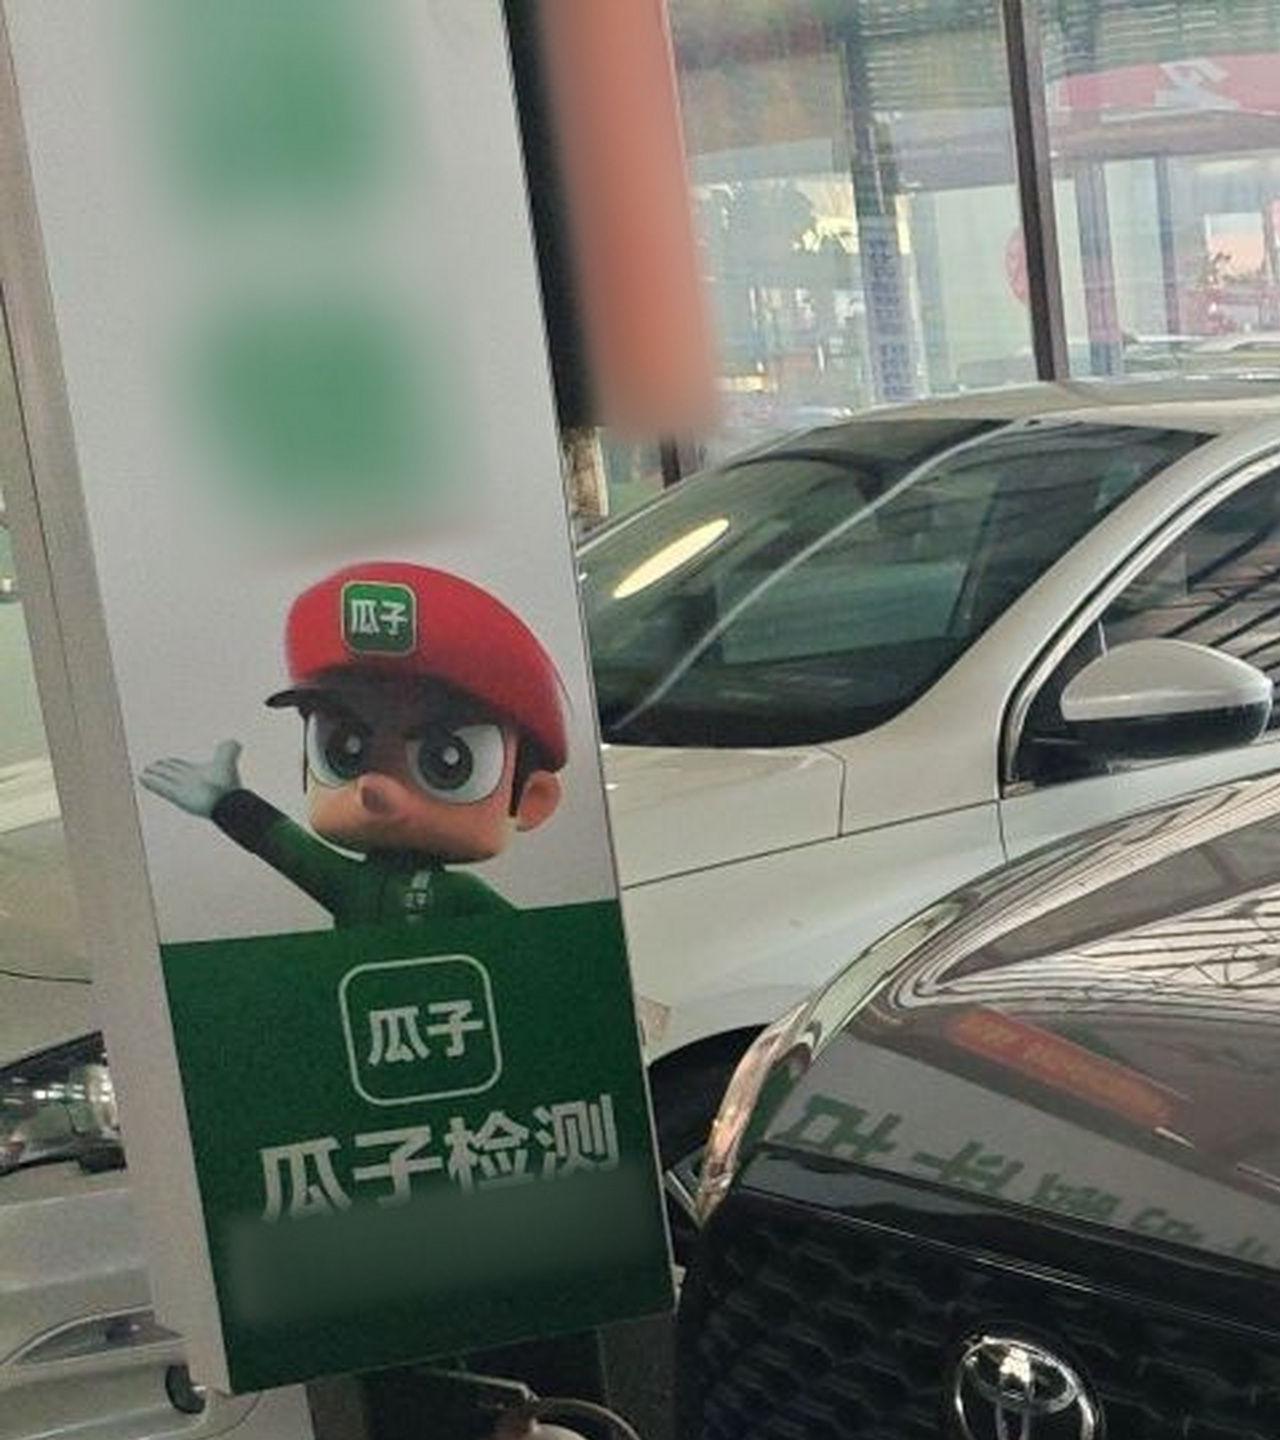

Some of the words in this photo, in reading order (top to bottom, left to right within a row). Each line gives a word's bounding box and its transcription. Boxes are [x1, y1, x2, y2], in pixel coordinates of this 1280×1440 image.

[351, 599, 409, 636] 瓜子
[368, 1000, 484, 1066] 瓜子
[260, 1094, 620, 1222] 瓜子检测
